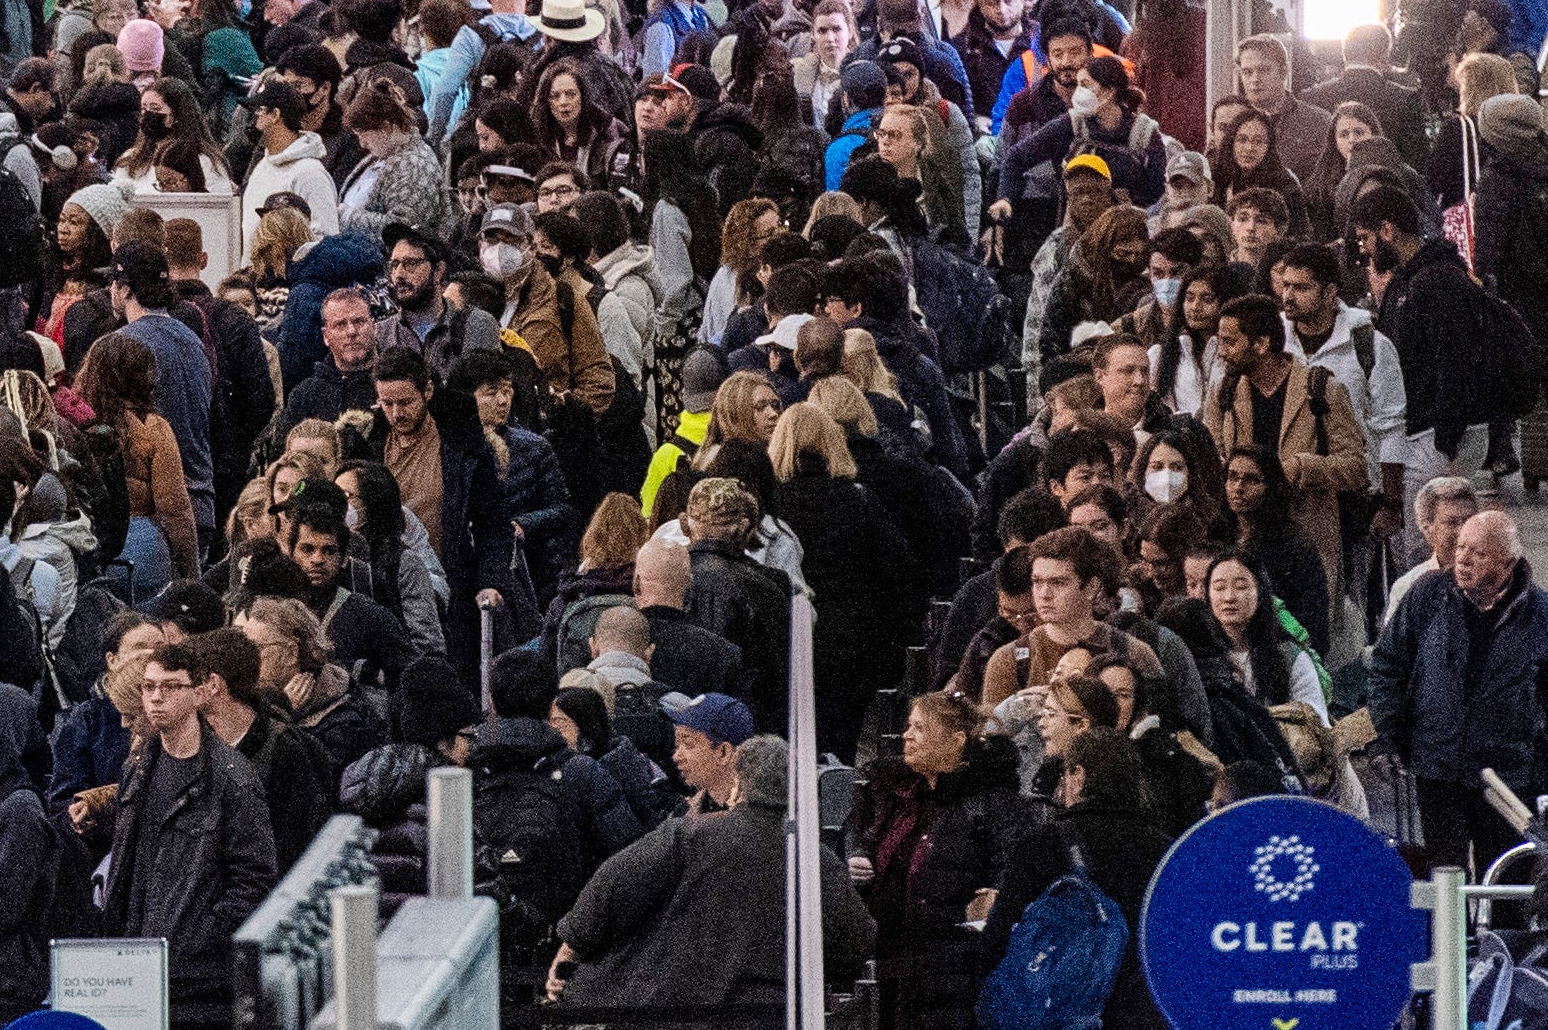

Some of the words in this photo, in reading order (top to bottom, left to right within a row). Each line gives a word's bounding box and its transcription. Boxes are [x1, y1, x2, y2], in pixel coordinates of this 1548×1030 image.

[1211, 921, 1358, 951] CLEAR
[1311, 954, 1358, 969] PLUS
[82, 977, 105, 987] YOU
[107, 977, 133, 987] HAVE
[1233, 989, 1291, 1003] ENROLL
[1294, 989, 1337, 1003] HERE
